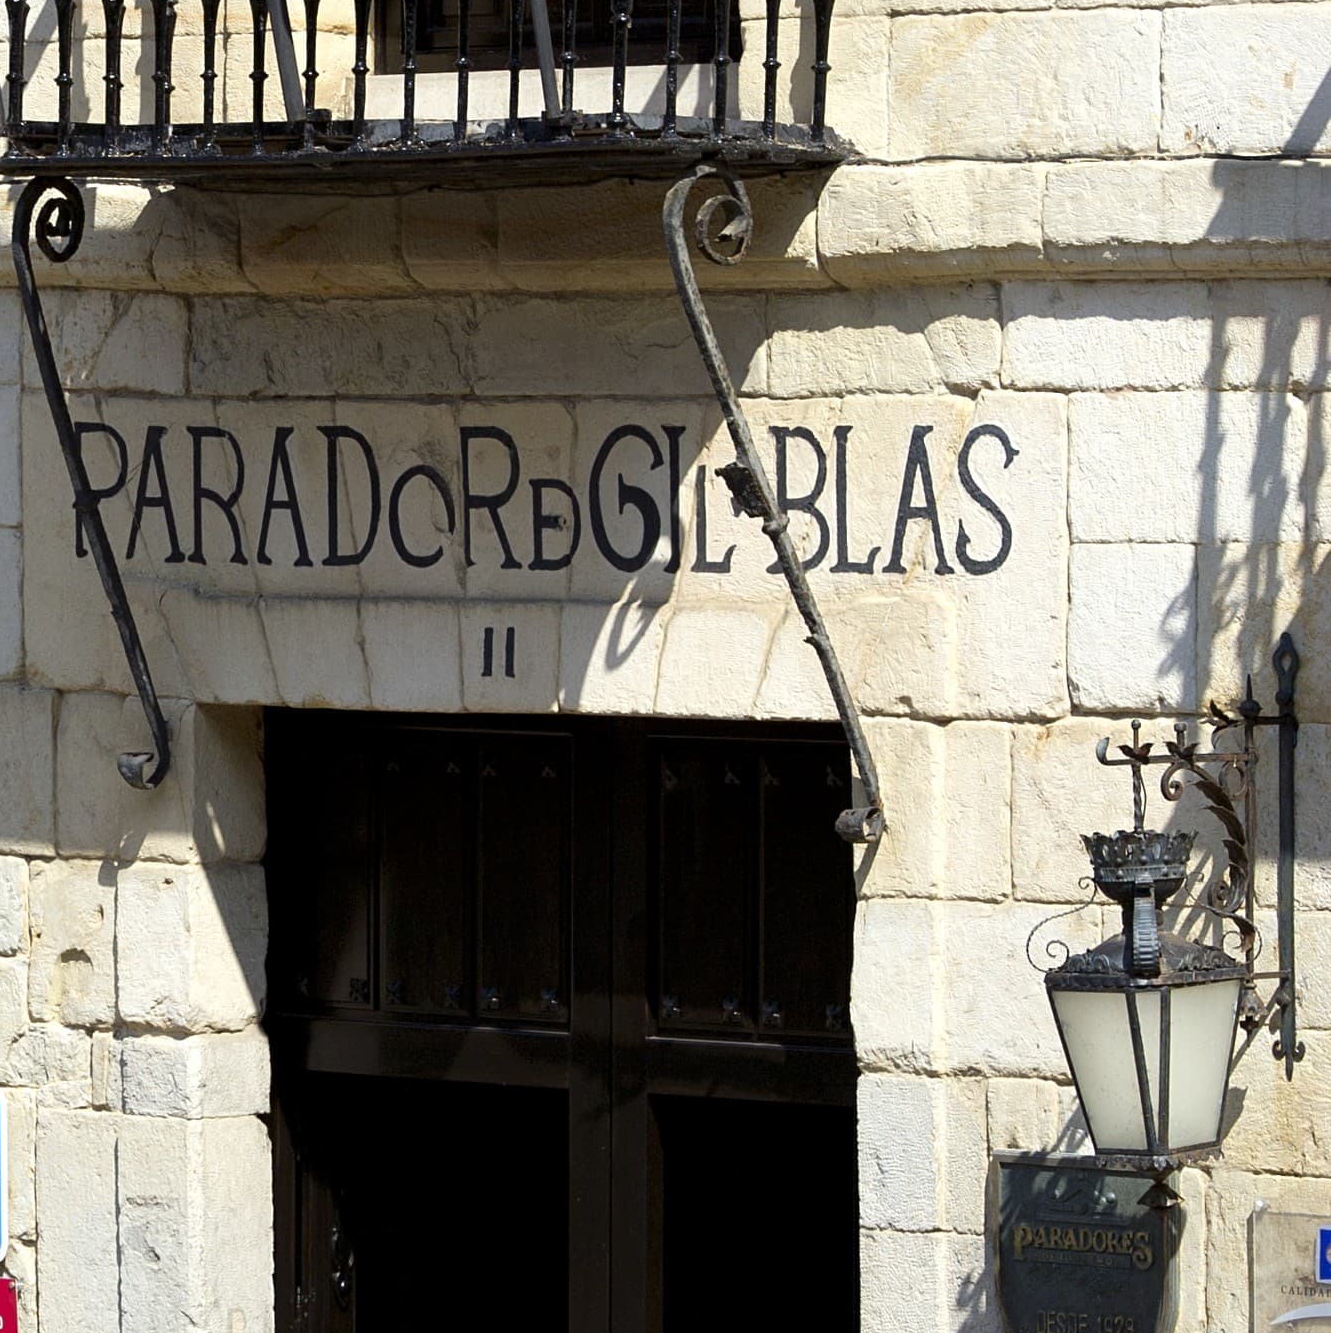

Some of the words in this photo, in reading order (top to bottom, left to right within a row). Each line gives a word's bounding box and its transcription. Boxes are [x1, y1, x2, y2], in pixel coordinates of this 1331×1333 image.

[72, 421, 523, 569] PARADOR
[588, 423, 738, 574] GIL
[766, 423, 1020, 576] BLAS
[1012, 1223, 1154, 1271] PARADORES
